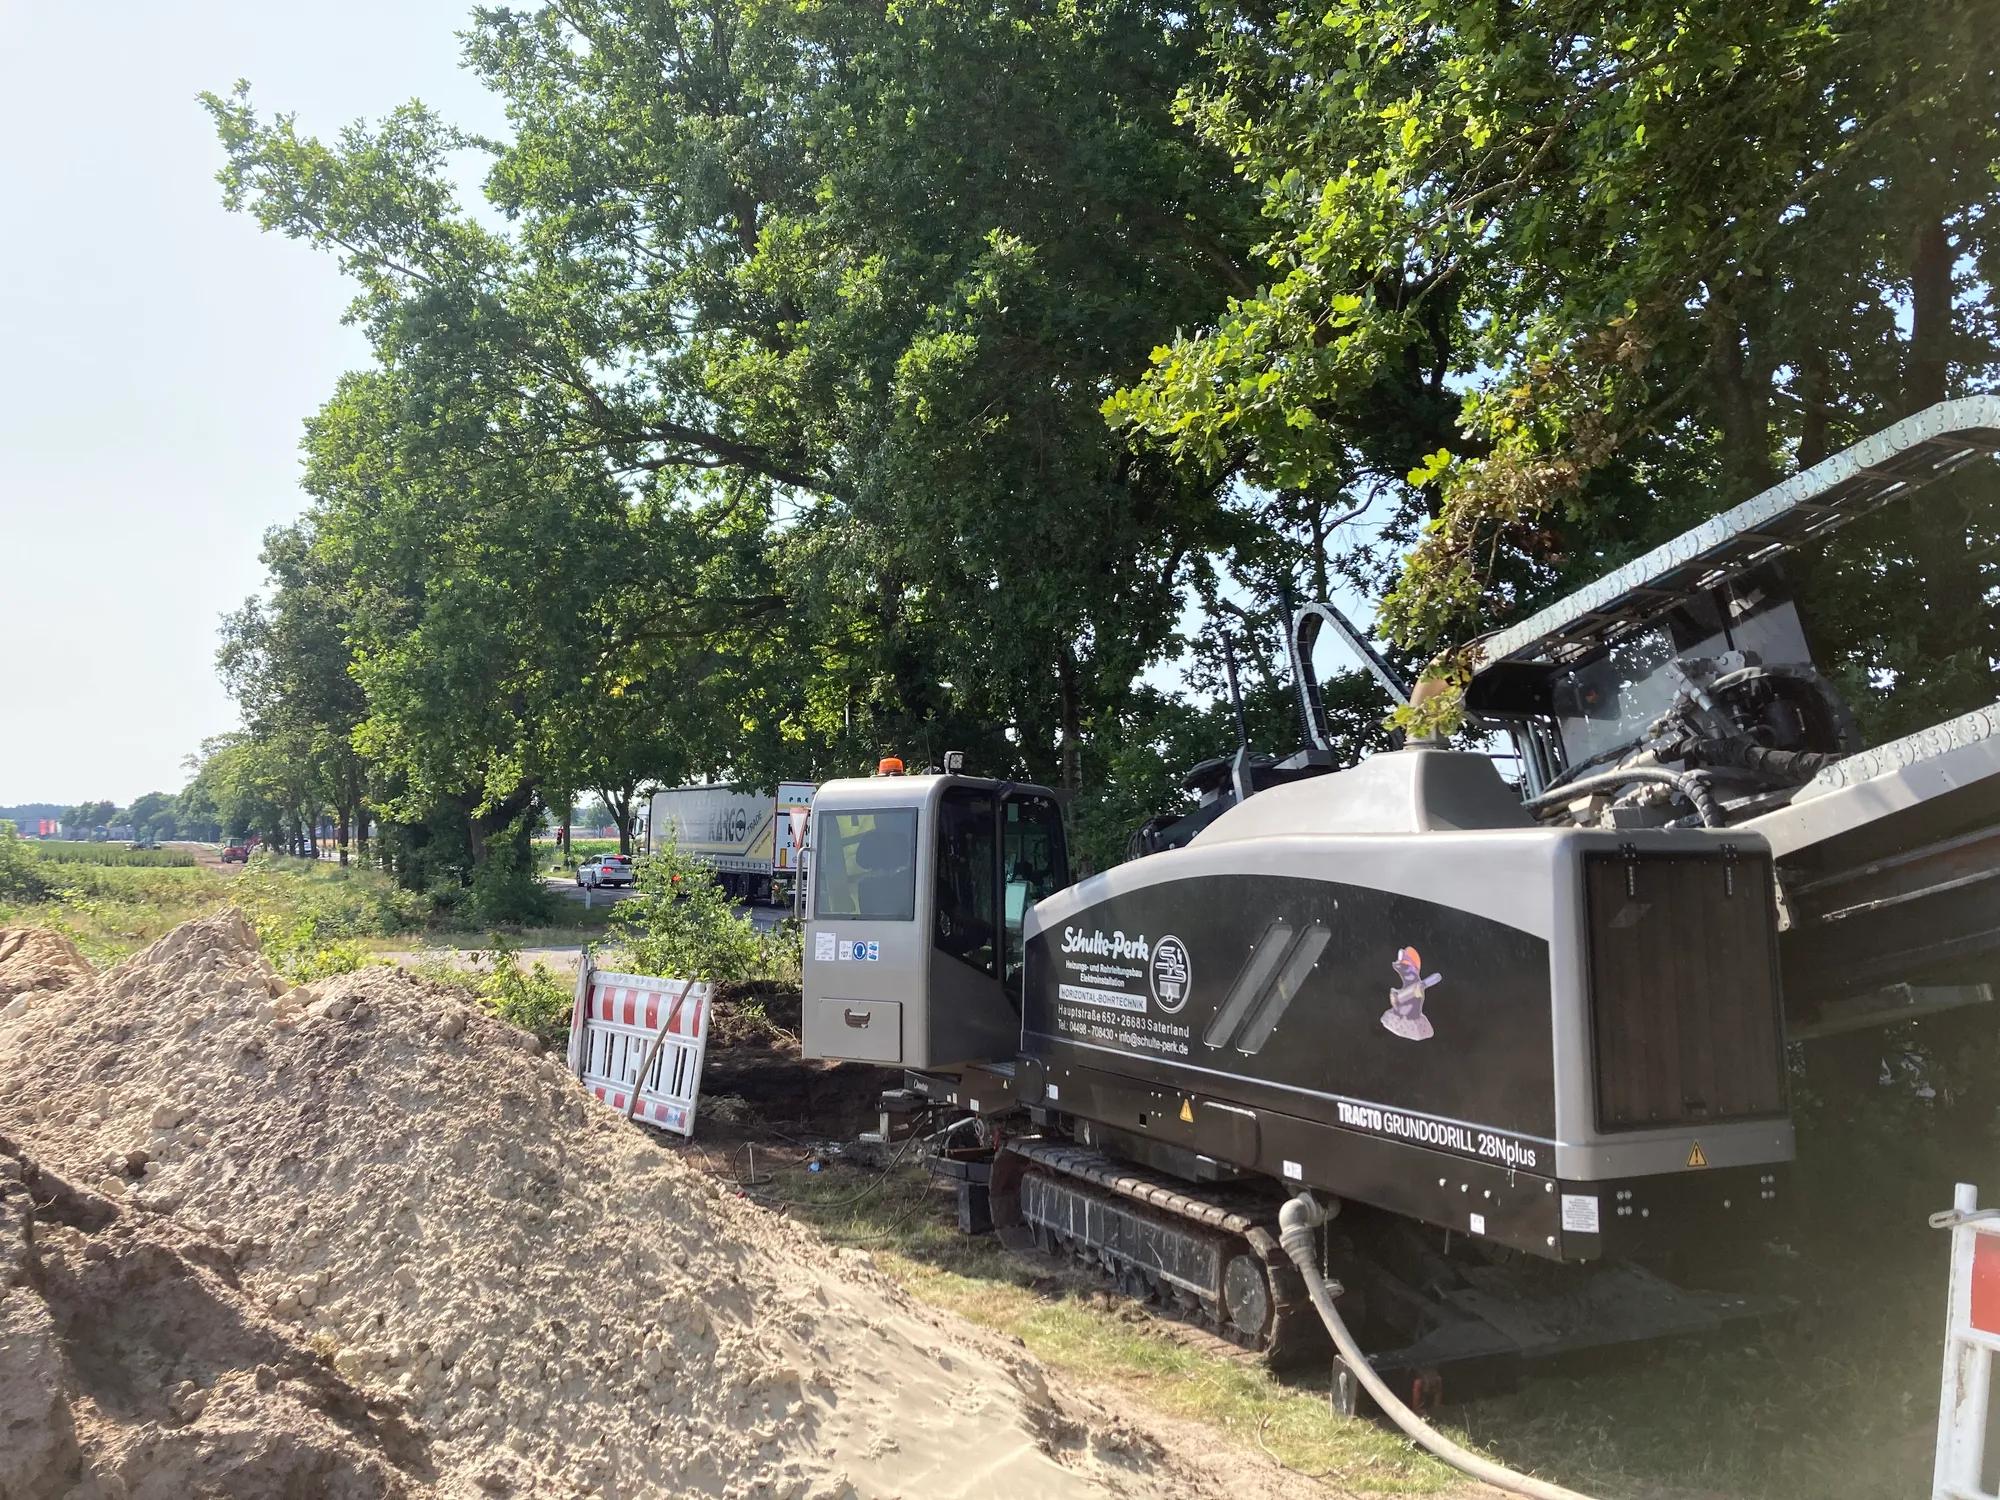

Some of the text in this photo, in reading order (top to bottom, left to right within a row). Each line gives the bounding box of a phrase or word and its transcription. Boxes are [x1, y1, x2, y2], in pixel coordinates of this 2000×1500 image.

[1061, 926, 1149, 961] Schulte-Perk
[1058, 1003, 1190, 1038] Hauptstraße 652 26683 Saterland
[1118, 1030, 1189, 1056] info@schulte-perk.de
[1337, 1102, 1536, 1167] TRACTO GRUNDODRILL 28Nplus
